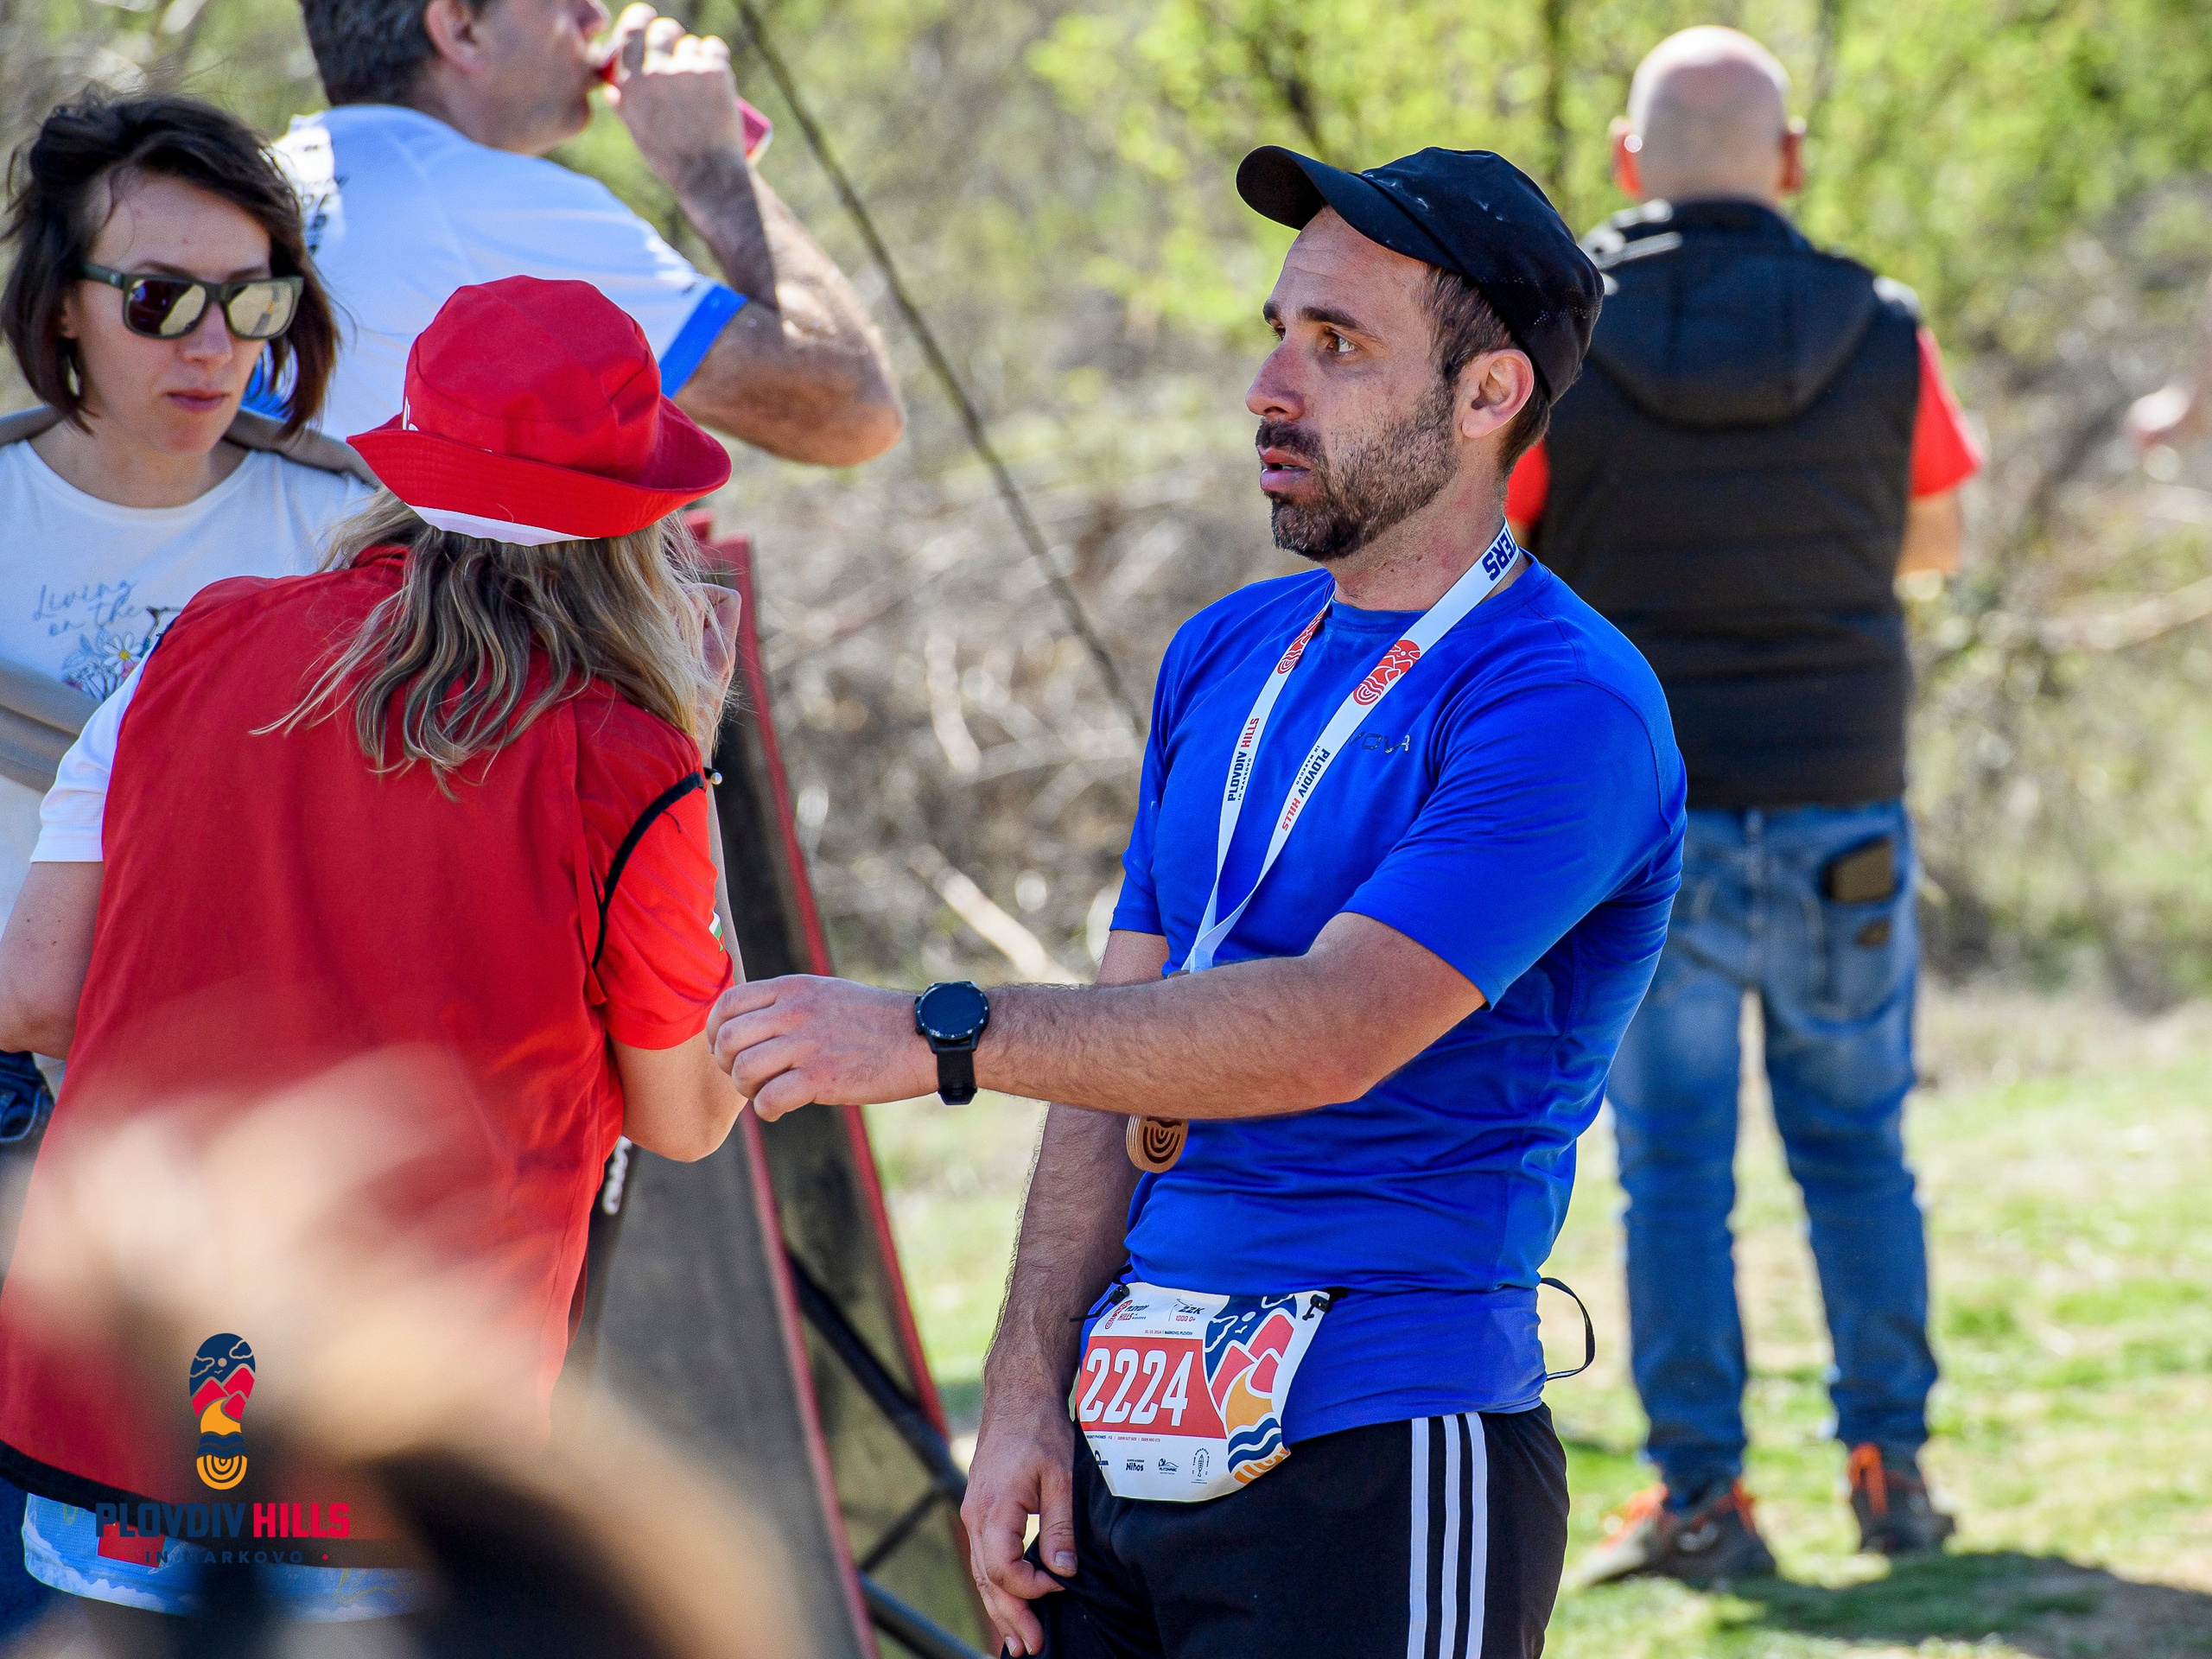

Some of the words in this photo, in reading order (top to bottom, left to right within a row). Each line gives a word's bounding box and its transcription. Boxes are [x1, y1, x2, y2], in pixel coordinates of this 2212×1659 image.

[1227, 751, 1247, 802] PLOVDIV
[1240, 717, 1260, 747] HILLS
[1298, 748, 1331, 798] PLOVDIV
[1281, 797, 1301, 831] HILLS
[1178, 1306, 1205, 1314] 22K
[1079, 1347, 1195, 1427] 2224
